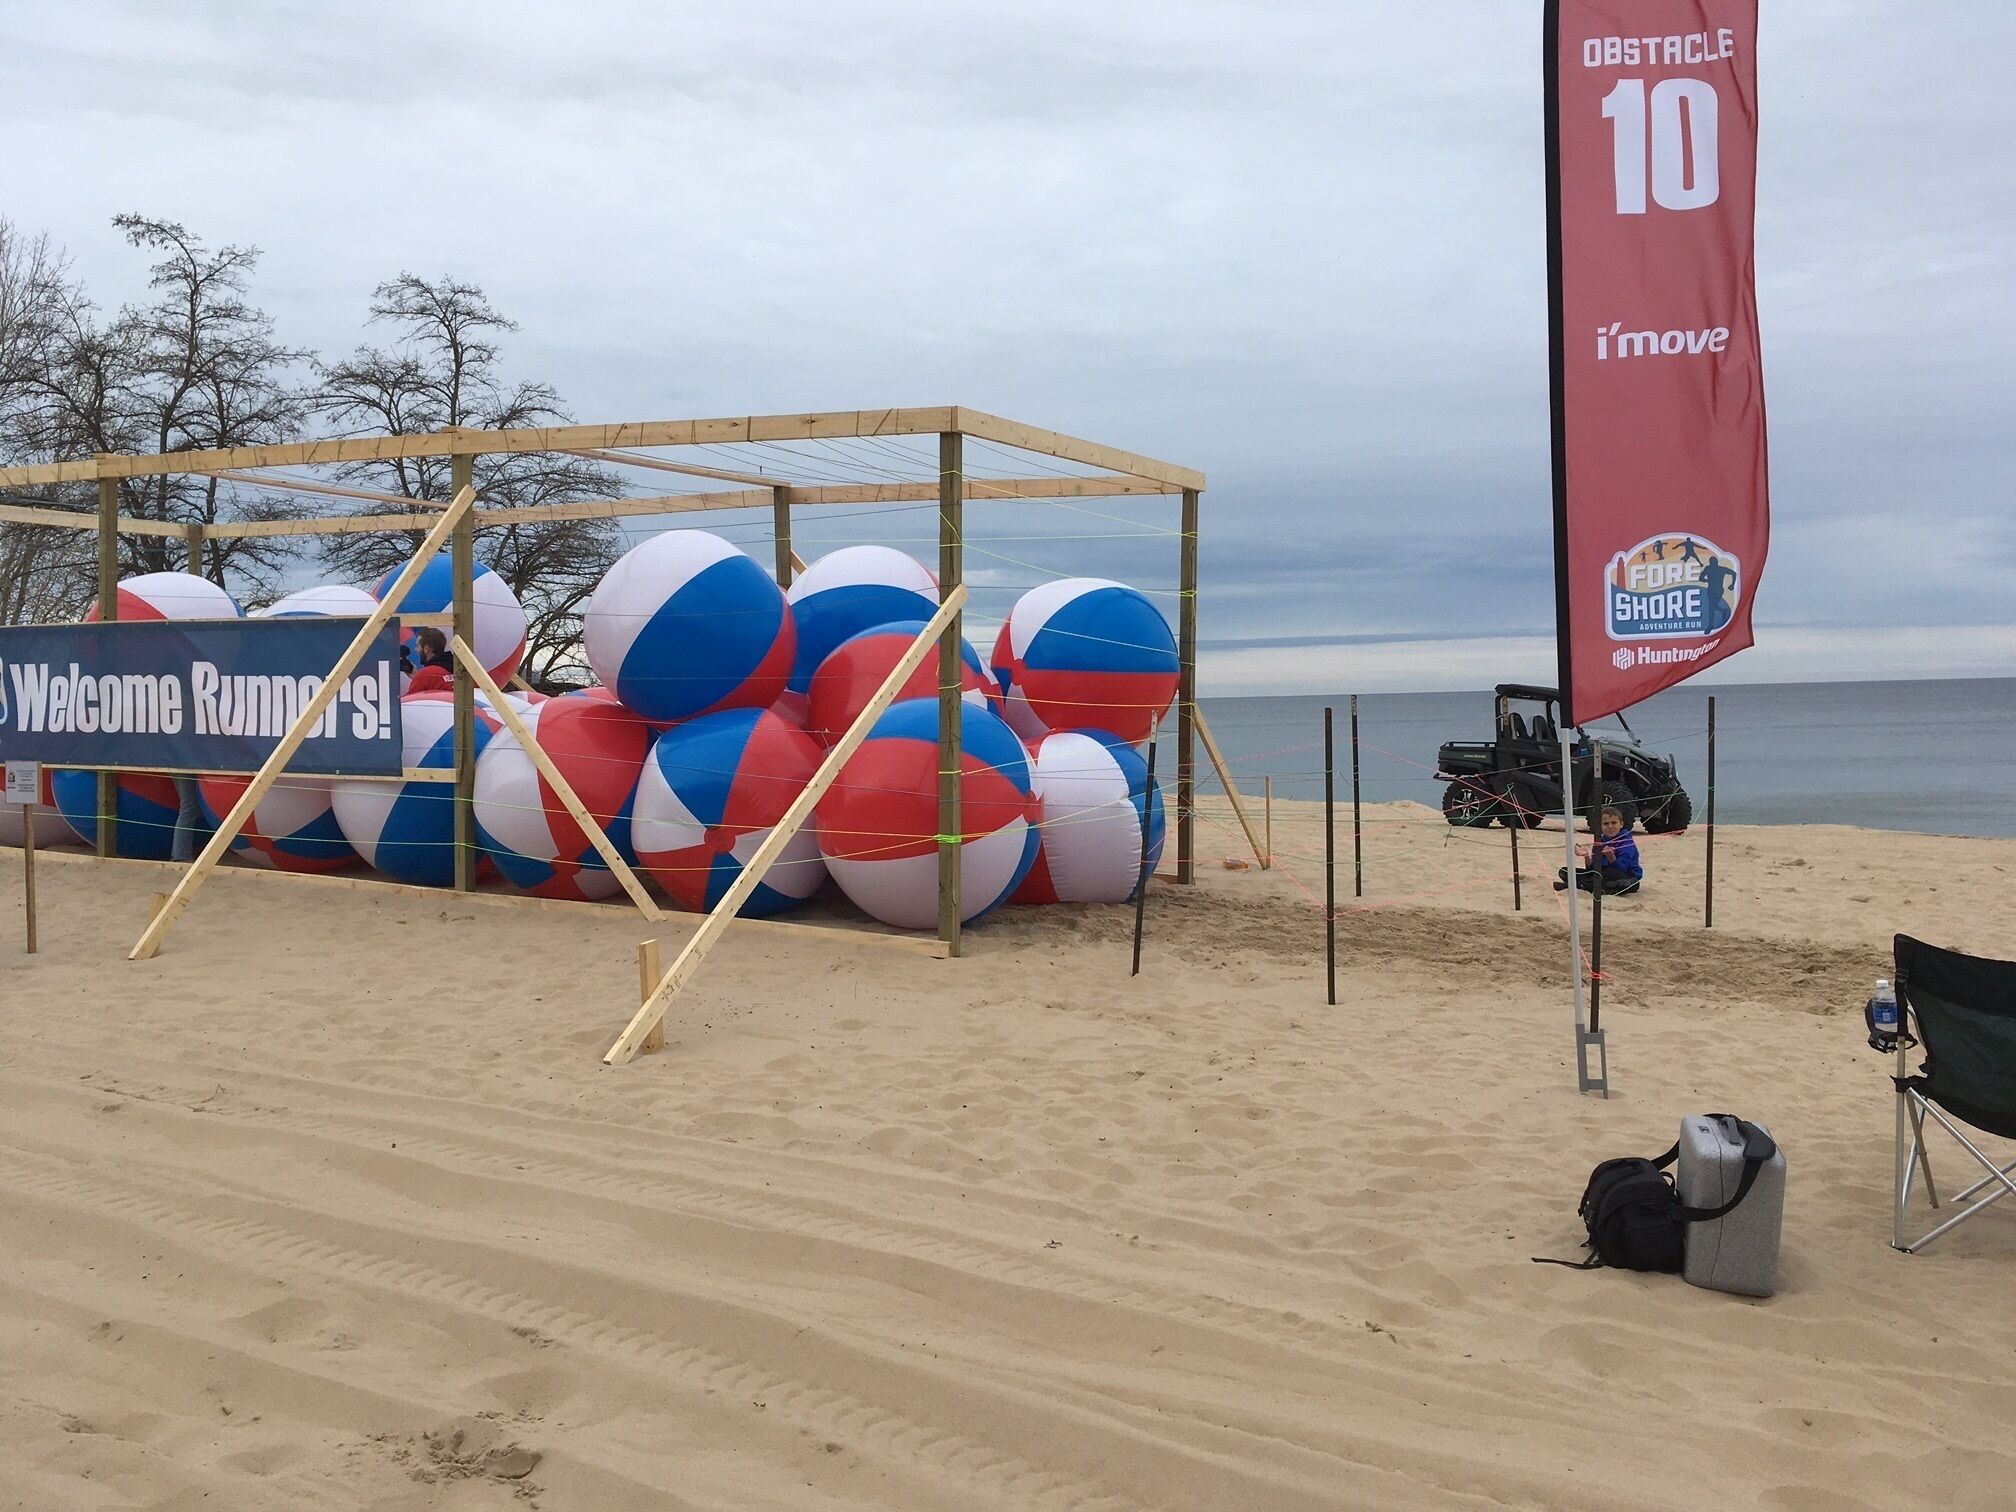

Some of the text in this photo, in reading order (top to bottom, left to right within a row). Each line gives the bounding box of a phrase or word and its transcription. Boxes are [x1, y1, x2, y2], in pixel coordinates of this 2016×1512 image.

[1583, 28, 1734, 67] OBSTACLE
[1601, 77, 1720, 214] 10
[1597, 322, 1730, 360] i'move
[1630, 562, 1701, 590] FORE
[1615, 588, 1702, 621] SHORE
[1639, 620, 1702, 631] ADVENTURE RUN
[1637, 638, 1720, 665] Huntington
[9, 662, 183, 735] Welcome
